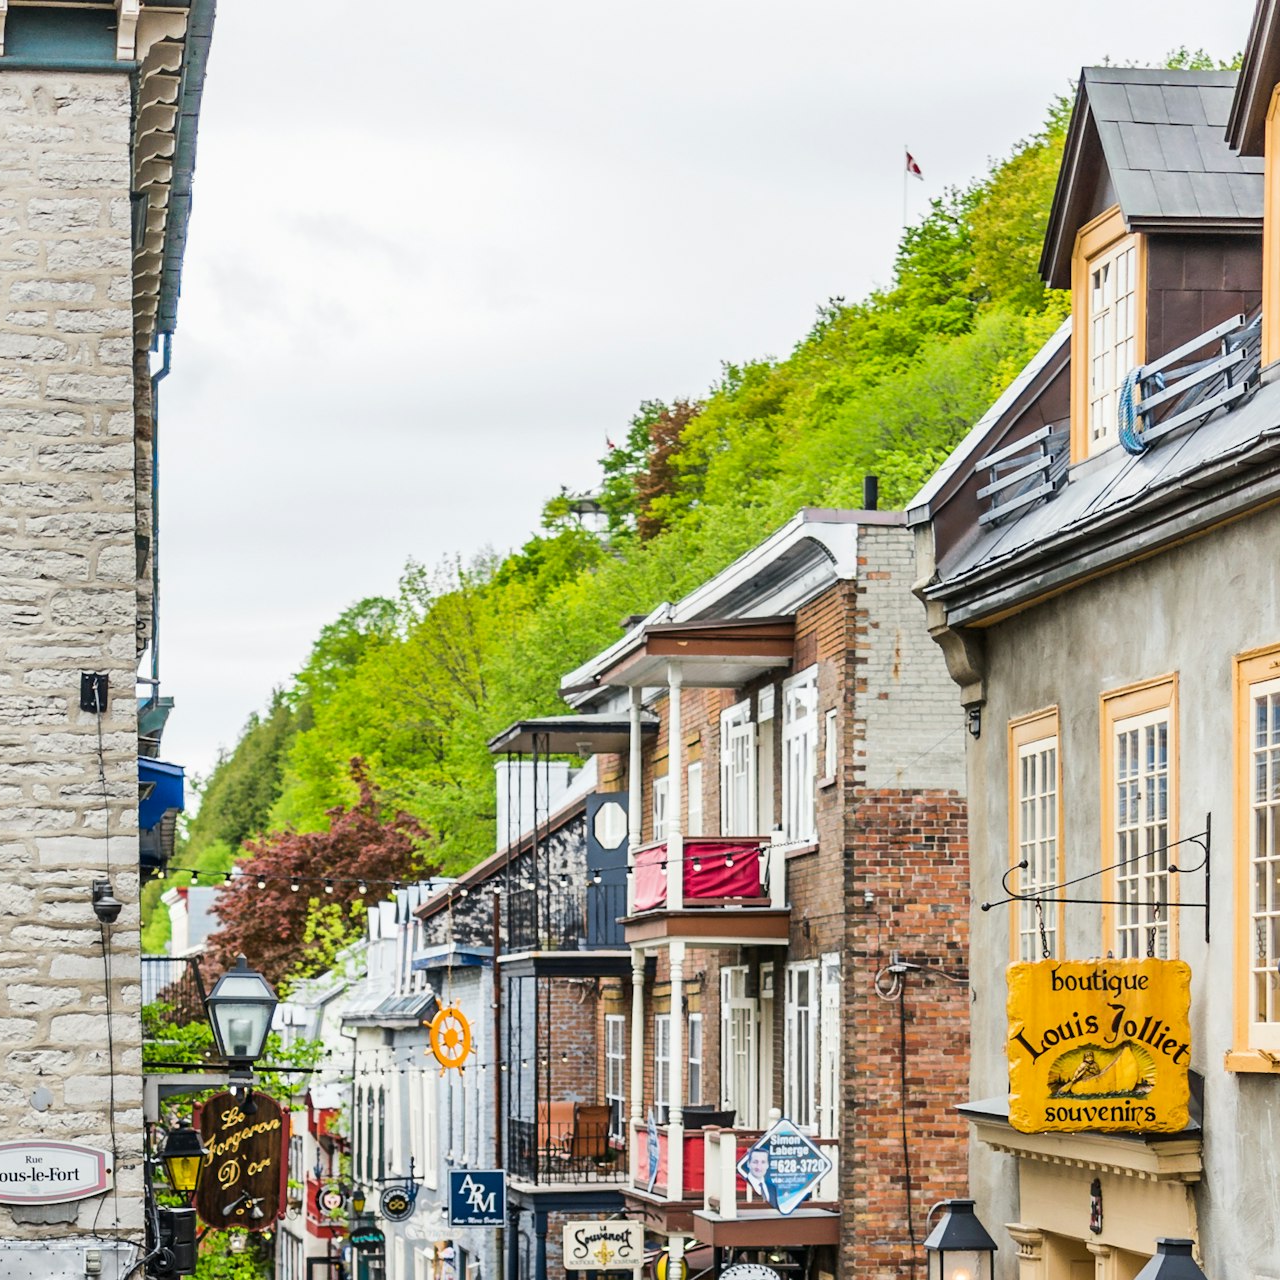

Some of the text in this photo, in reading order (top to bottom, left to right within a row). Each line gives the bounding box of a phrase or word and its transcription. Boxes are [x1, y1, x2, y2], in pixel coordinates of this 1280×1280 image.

[1051, 964, 1148, 998] boutique
[1010, 1002, 1190, 1065] Louis Jolliet
[221, 1106, 246, 1130] Le
[1044, 1100, 1156, 1126] souvenirs
[204, 1118, 281, 1167] Forgeron
[769, 1145, 809, 1157] Laberge
[770, 1134, 801, 1146] Simon
[25, 1155, 43, 1164] Rue
[777, 1158, 825, 1173] 628-3720
